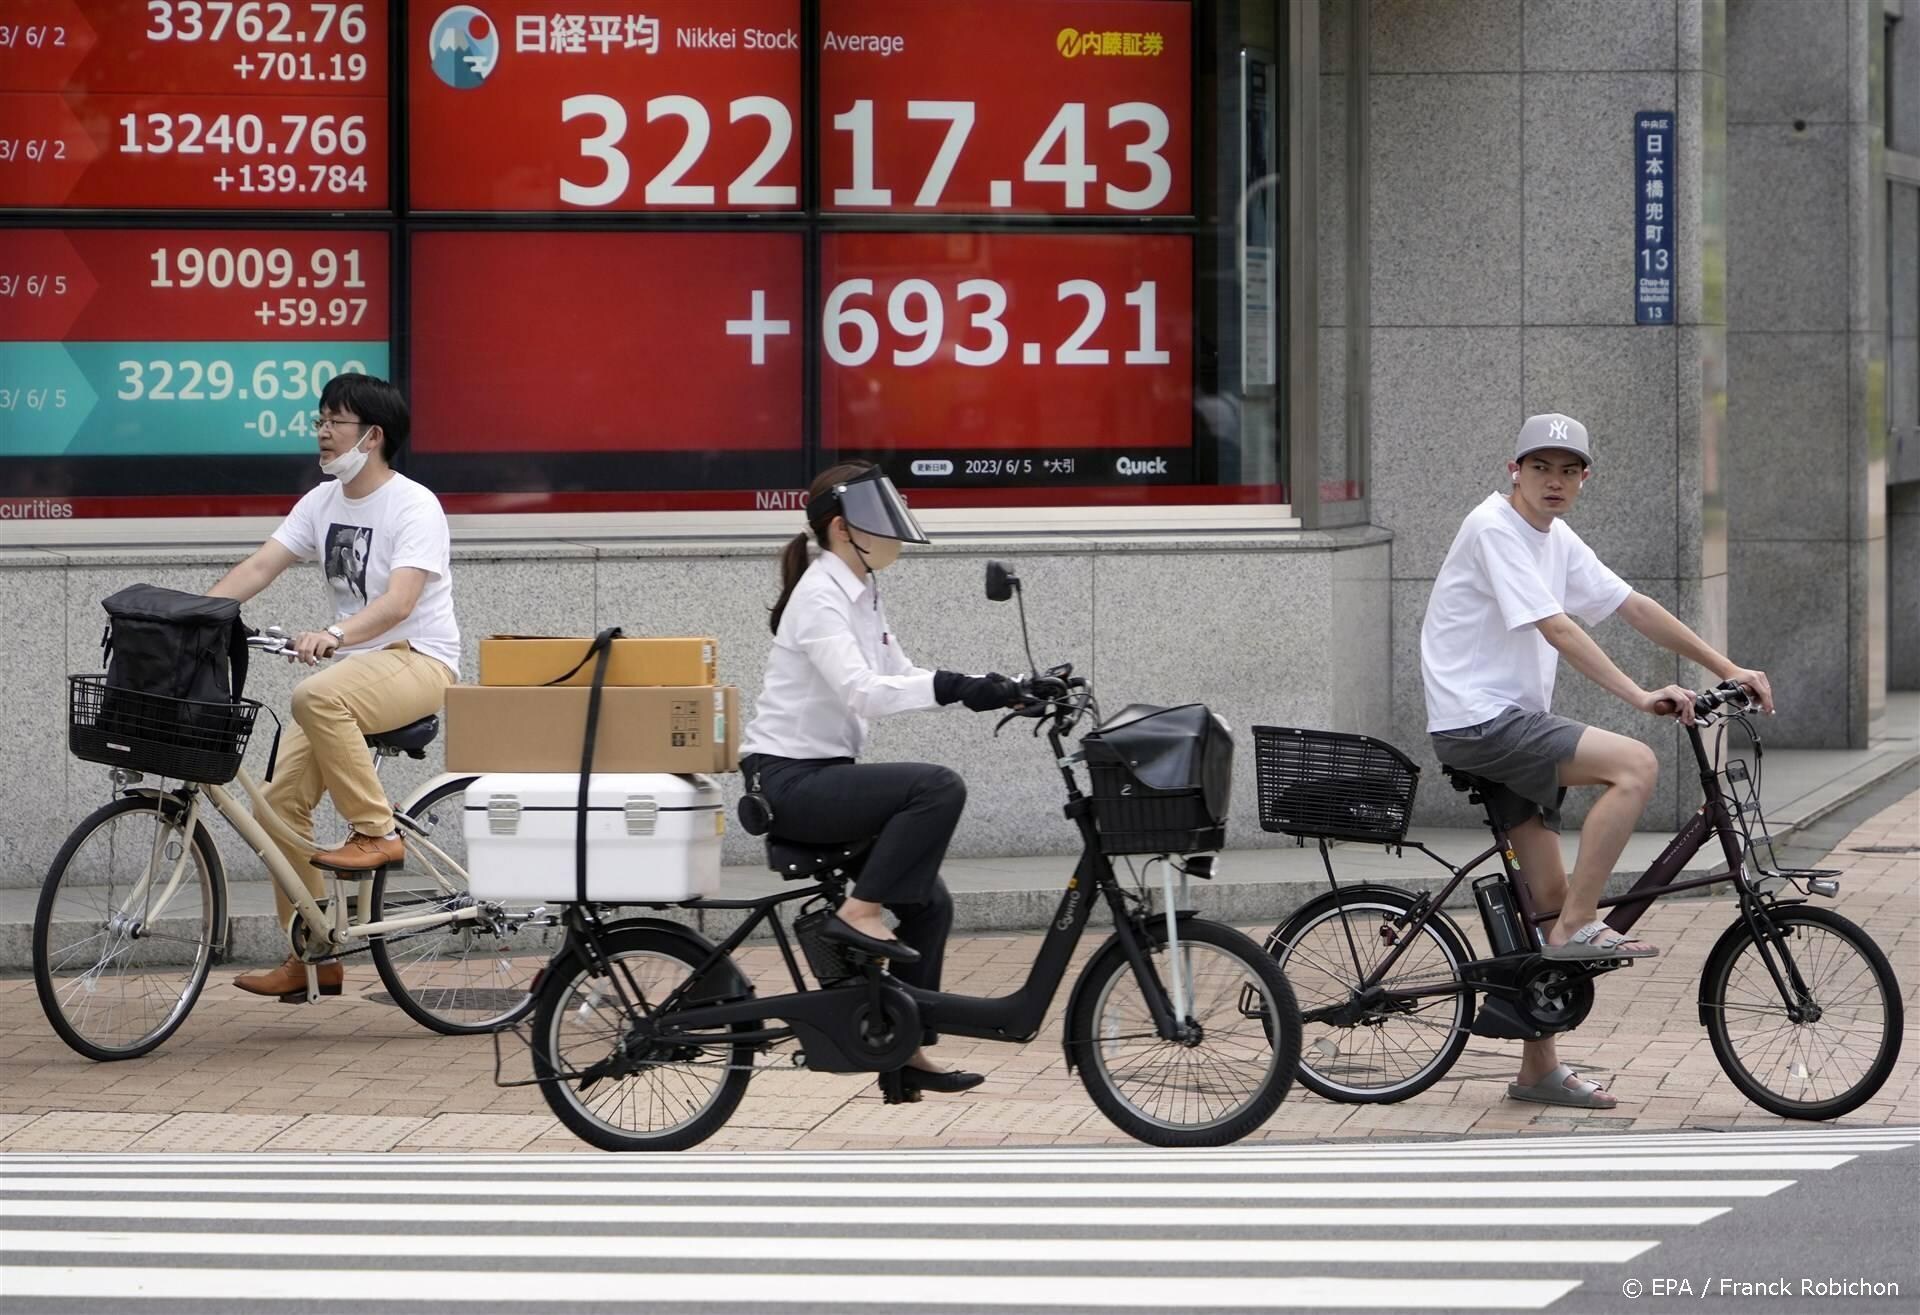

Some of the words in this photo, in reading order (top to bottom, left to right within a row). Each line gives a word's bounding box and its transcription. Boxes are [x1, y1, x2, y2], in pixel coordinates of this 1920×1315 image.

[147, 0, 366, 43] 33762.76
[515, 14, 660, 55] 日経平均
[676, 28, 736, 49] Nikkei
[743, 29, 798, 49] Stock
[824, 32, 904, 56] Average
[1081, 31, 1163, 56] 内藤証券
[234, 53, 367, 81] +701.19
[120, 113, 366, 155] 13240.766
[1641, 119, 1668, 129] 中央区
[560, 94, 1172, 210] 32217.43
[214, 164, 367, 192] +139.784
[1645, 134, 1664, 243] 日本橋兜町
[151, 248, 365, 288] 19009.91
[1641, 248, 1669, 271] 13
[255, 298, 367, 326] +59.97
[1648, 306, 1663, 319] 13
[118, 360, 367, 400] 3229.630
[1549, 419, 1568, 440] NY
